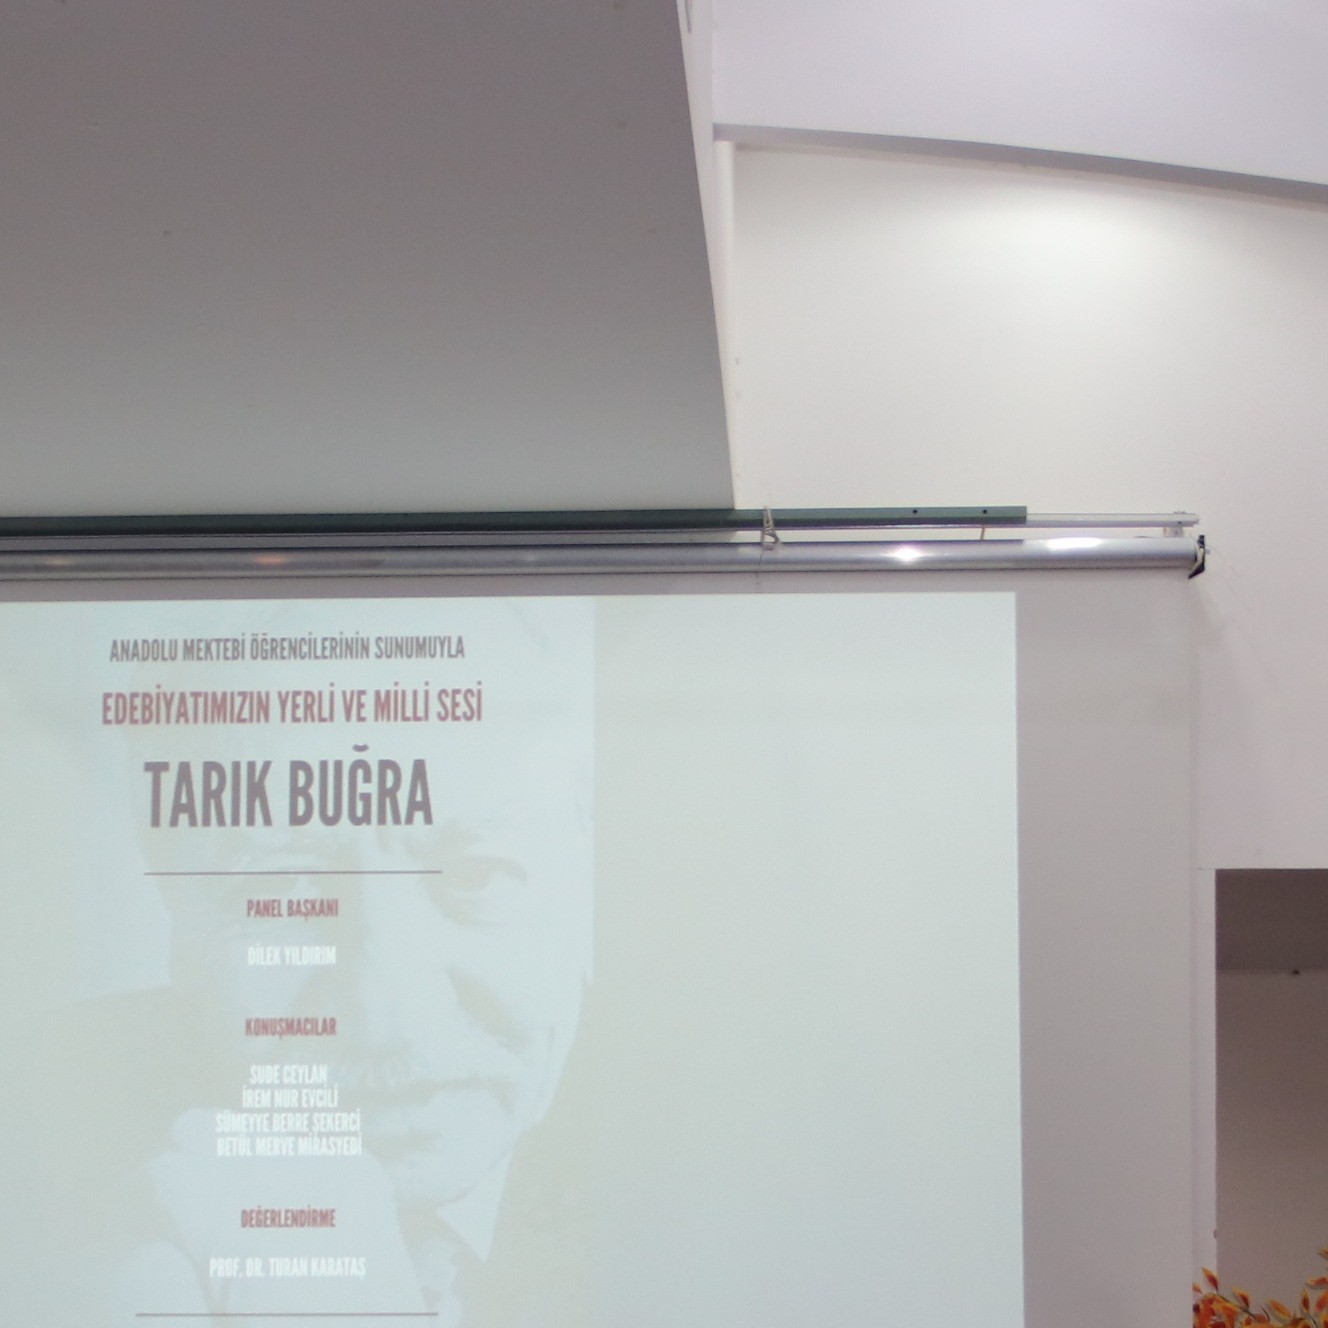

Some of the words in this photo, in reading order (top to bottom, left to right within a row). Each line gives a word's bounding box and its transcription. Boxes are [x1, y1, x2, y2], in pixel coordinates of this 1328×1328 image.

[109, 638, 178, 662] ANADOLU
[182, 632, 246, 662] MEKTEBİ
[250, 631, 371, 661] ÖĞRENCİLERİNİN
[374, 635, 466, 659] SUNUMUYLA
[102, 684, 271, 725] EDEBİYATIMIZIN
[277, 682, 335, 723] YERLİ
[342, 689, 368, 723] VE
[373, 681, 430, 722] MİLLİ
[436, 680, 483, 722] SESİ
[143, 760, 272, 828] TARIK
[288, 743, 434, 827] BUĞRA
[247, 898, 284, 918] PANEL
[287, 898, 339, 922] BAŞKANI
[247, 941, 282, 966] DİLEK
[283, 945, 337, 966] YILDIRIM
[244, 1017, 338, 1040] KONUŞMACILAR
[249, 1064, 281, 1085] SUDE
[282, 1064, 328, 1085] CEYLAN
[241, 1085, 272, 1109] İREM
[274, 1088, 299, 1109] NUR
[240, 1205, 336, 1228] DEĞERLENDİRME
[209, 1257, 243, 1278] PROF.
[268, 1256, 308, 1277] TURAN
